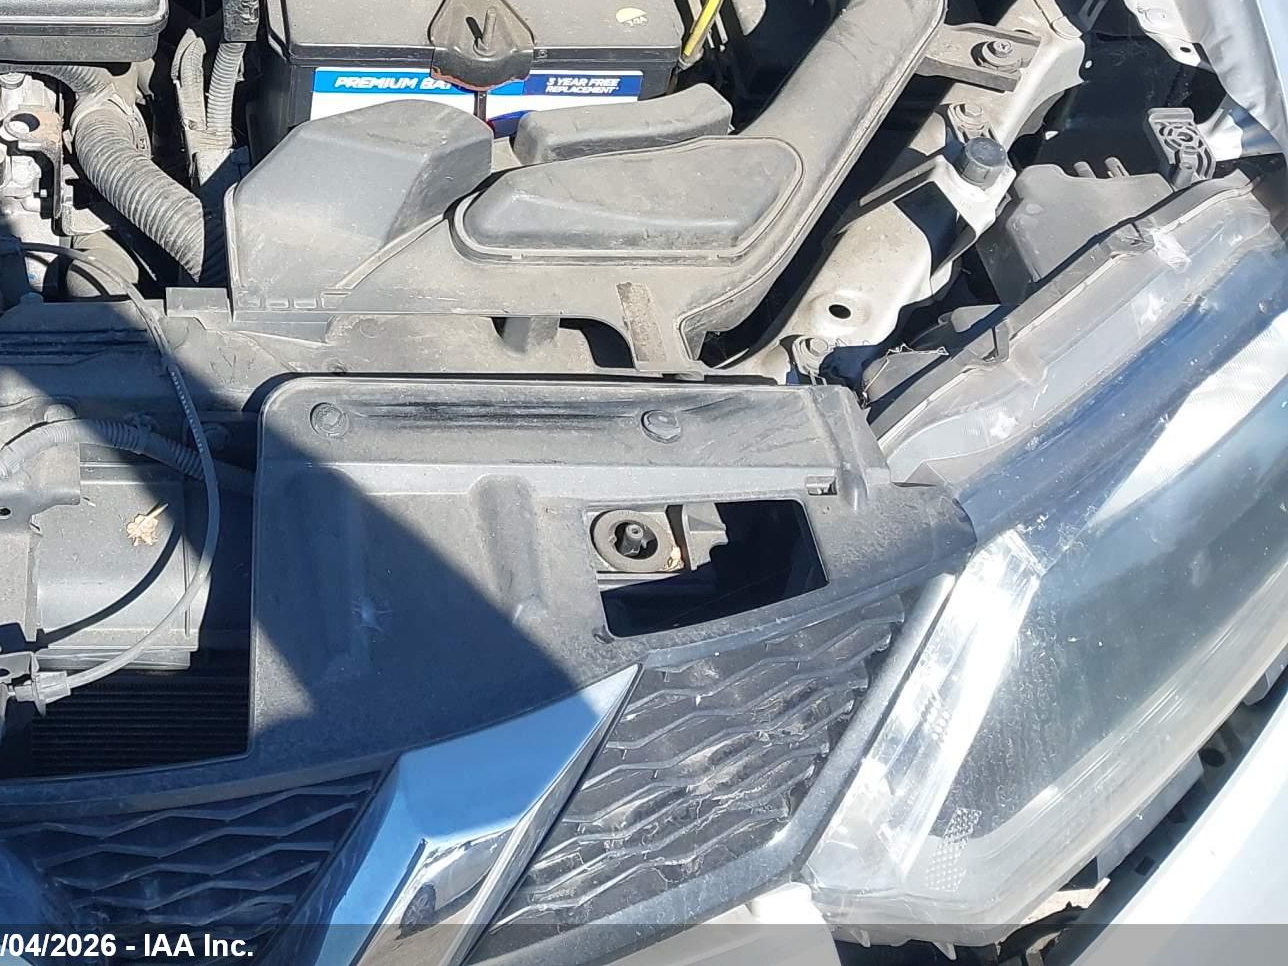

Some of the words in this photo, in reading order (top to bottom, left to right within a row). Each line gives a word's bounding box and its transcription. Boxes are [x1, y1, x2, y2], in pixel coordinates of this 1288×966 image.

[334, 76, 419, 90] PREMIUM
[546, 77, 557, 87] 3
[557, 78, 586, 87] YEAR
[588, 78, 621, 87] FREE
